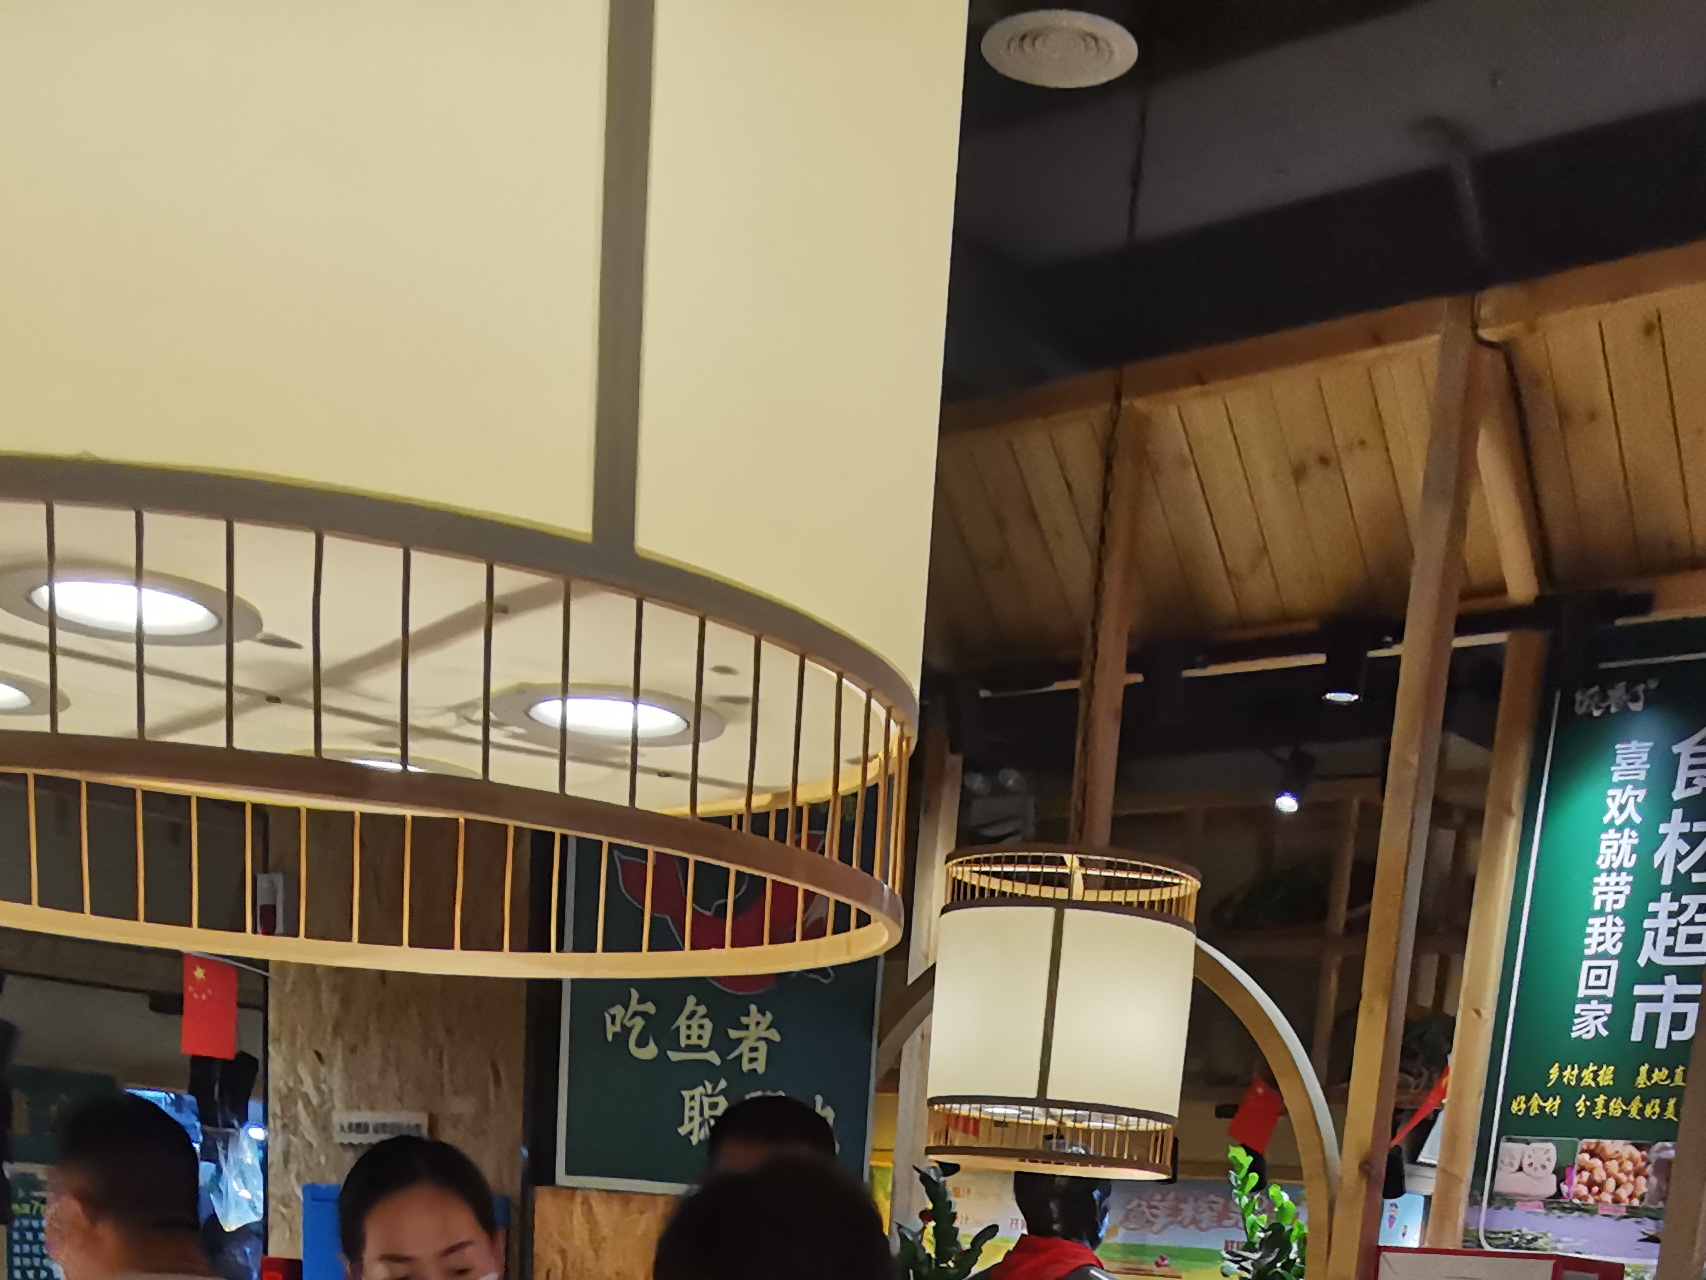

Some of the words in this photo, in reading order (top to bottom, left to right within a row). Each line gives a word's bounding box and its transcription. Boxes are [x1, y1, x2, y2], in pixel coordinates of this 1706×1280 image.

[1570, 739, 1655, 1040] 喜欢就带我回家
[603, 986, 782, 1075] 吃鱼者
[1510, 1092, 1562, 1117] 好食材
